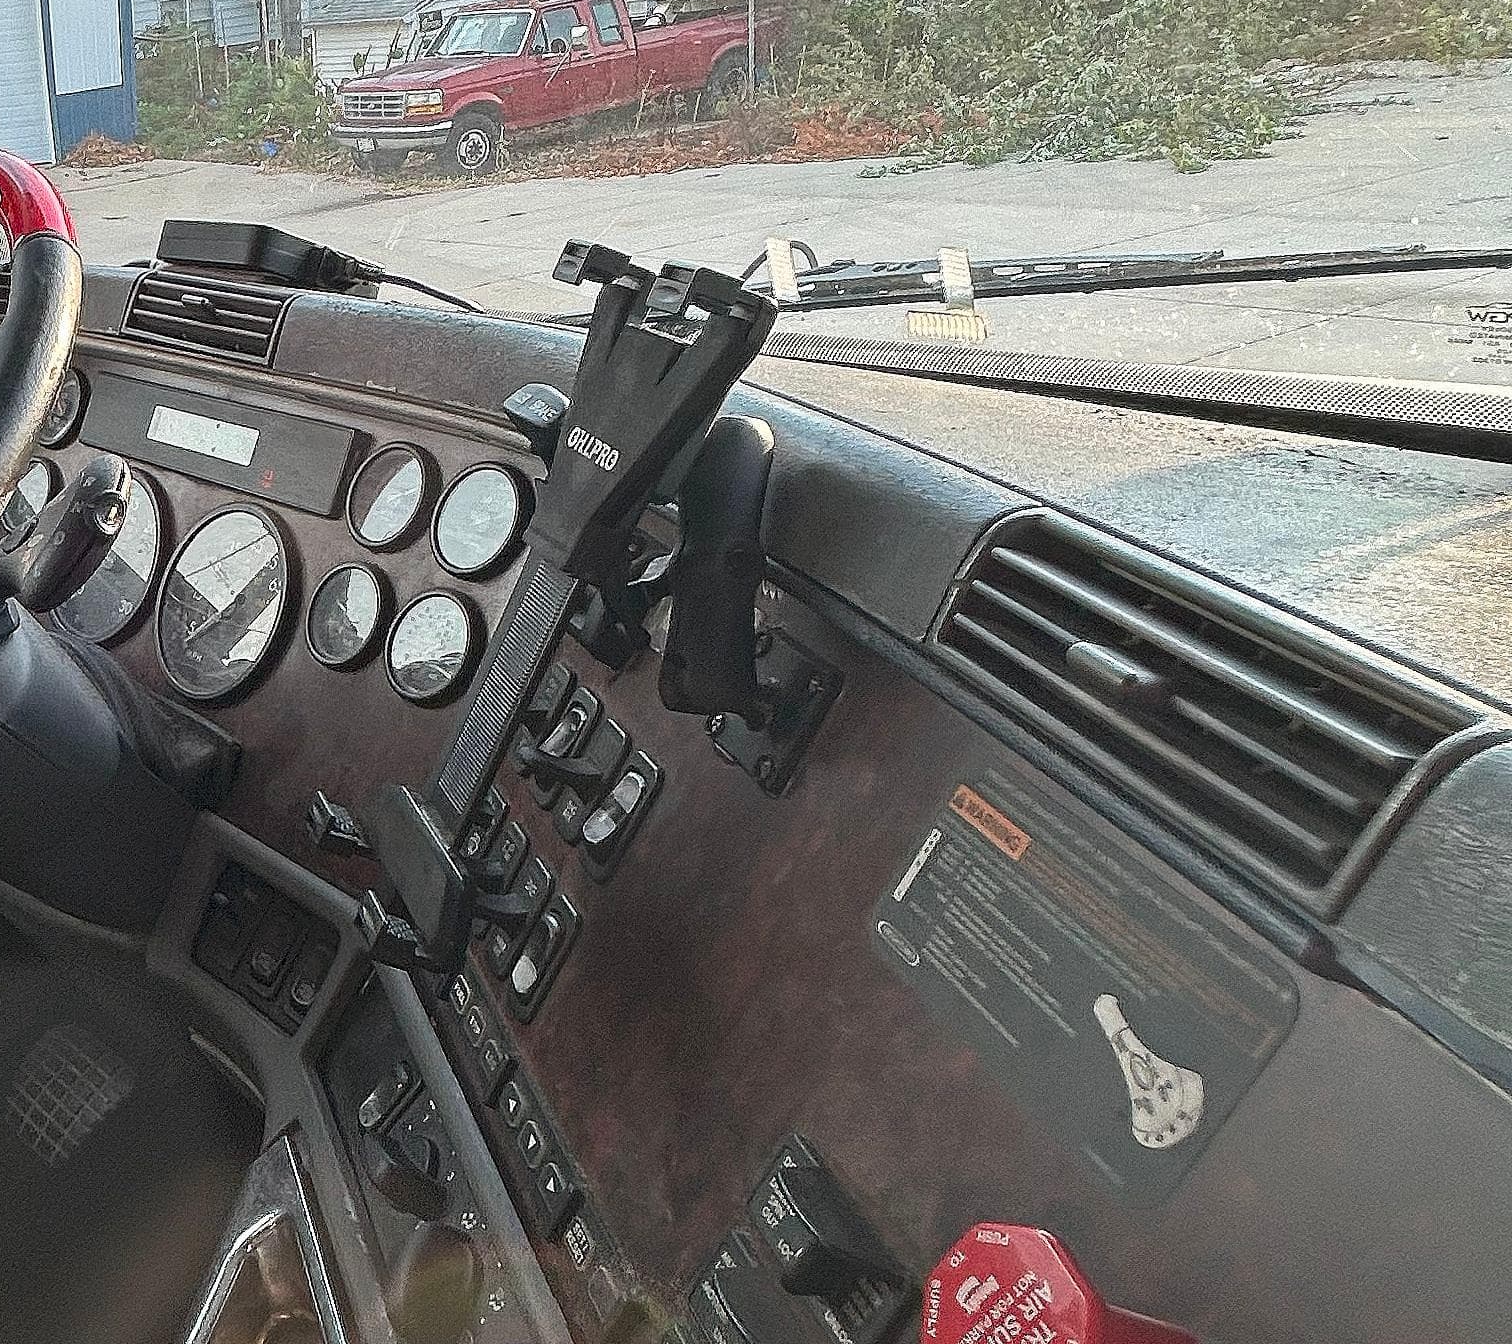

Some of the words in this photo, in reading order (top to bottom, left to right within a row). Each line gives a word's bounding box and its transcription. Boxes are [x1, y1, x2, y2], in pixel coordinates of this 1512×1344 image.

[976, 1230, 1010, 1246] PUSH
[949, 1251, 965, 1268] TO
[1012, 1270, 1038, 1299] NOT
[926, 1278, 941, 1338] SUPPLY
[989, 1292, 1015, 1320] FOR
[1017, 1278, 1054, 1322] AIR
